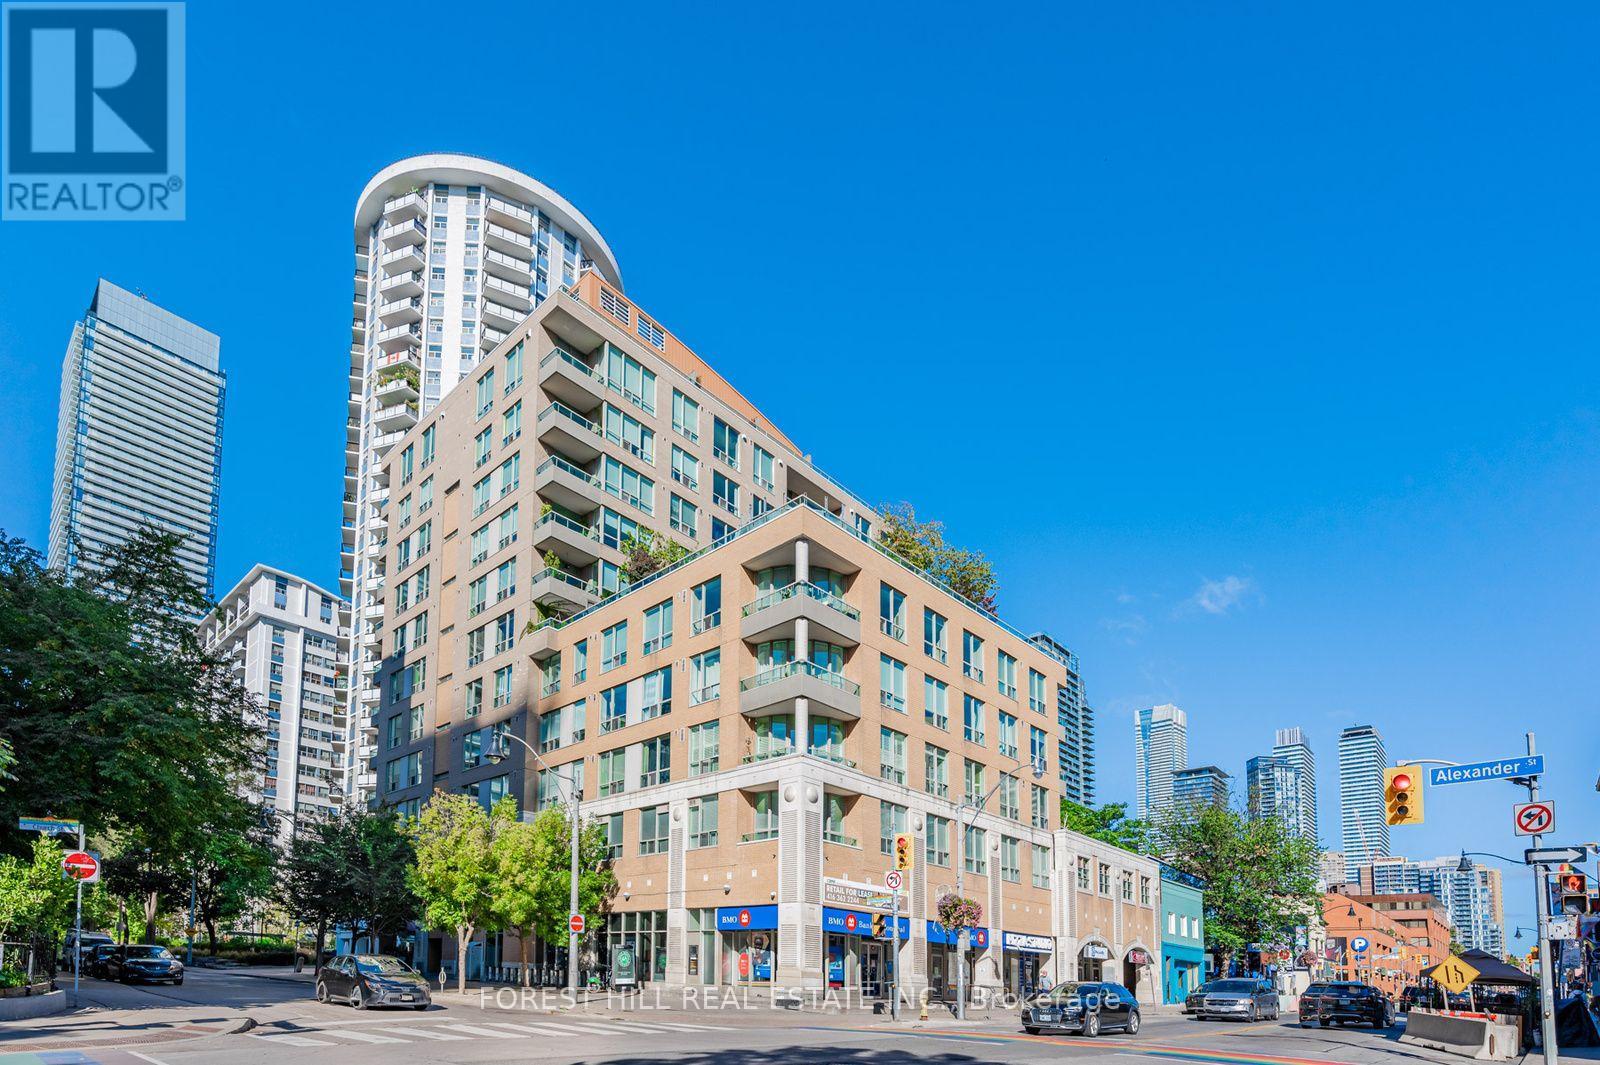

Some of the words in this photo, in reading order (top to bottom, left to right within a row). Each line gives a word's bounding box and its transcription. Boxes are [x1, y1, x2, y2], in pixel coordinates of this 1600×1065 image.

[1435, 761, 1520, 782] Alexander
[1527, 757, 1537, 766] St
[827, 884, 846, 895] RETAIL
[846, 887, 857, 896] FOR
[722, 915, 738, 924] BMO
[828, 916, 844, 926] BMO
[1354, 938, 1366, 949] P
